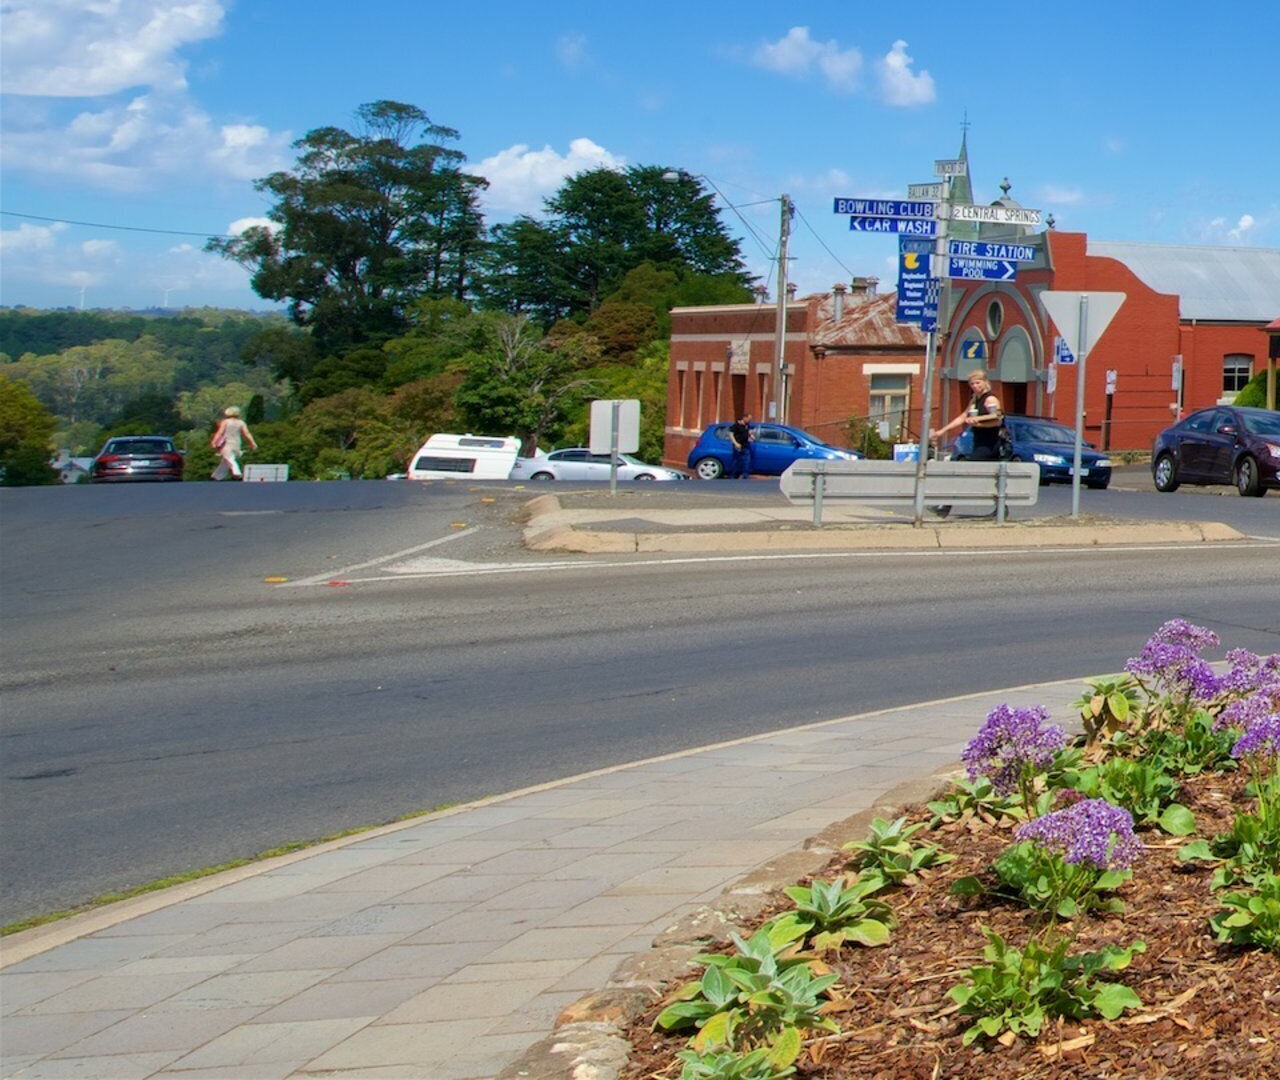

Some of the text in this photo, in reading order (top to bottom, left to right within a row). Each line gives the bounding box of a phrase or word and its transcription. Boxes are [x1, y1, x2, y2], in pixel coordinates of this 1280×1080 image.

[838, 199, 933, 217] BOWLING CLUB
[962, 205, 1000, 221] CENTRAL
[1004, 208, 1041, 224] SPRINGS
[865, 218, 932, 234] CAR WASH
[951, 241, 978, 255] FIRE
[985, 244, 1033, 260] STATION
[951, 258, 999, 271] SWIMMING
[962, 268, 986, 279] POOL
